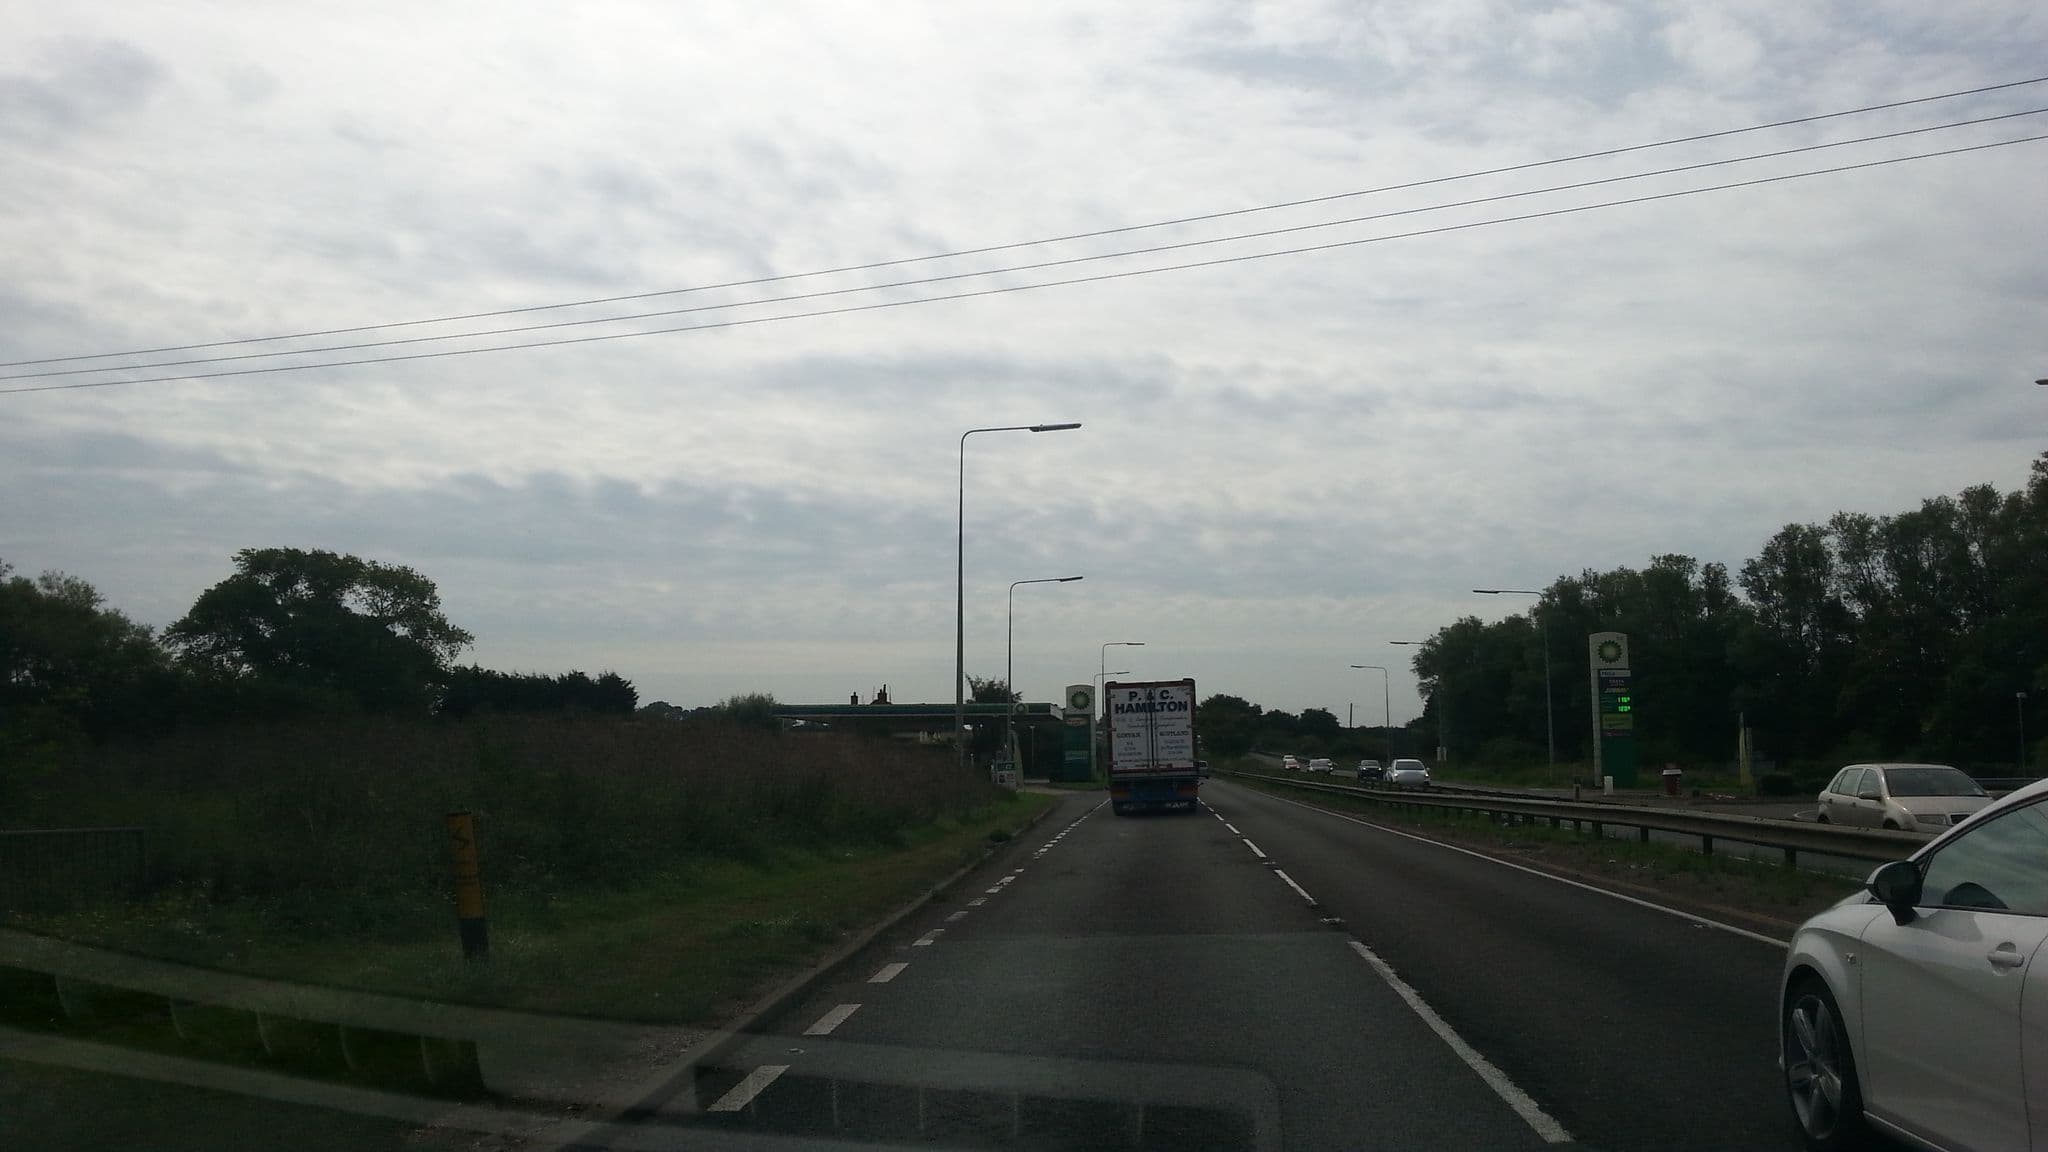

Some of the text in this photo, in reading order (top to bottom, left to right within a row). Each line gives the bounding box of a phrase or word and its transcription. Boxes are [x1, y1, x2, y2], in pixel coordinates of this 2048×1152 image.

[1129, 691, 1142, 701] P.
[1160, 689, 1174, 700] C.
[1115, 701, 1188, 714] HAMILTON
